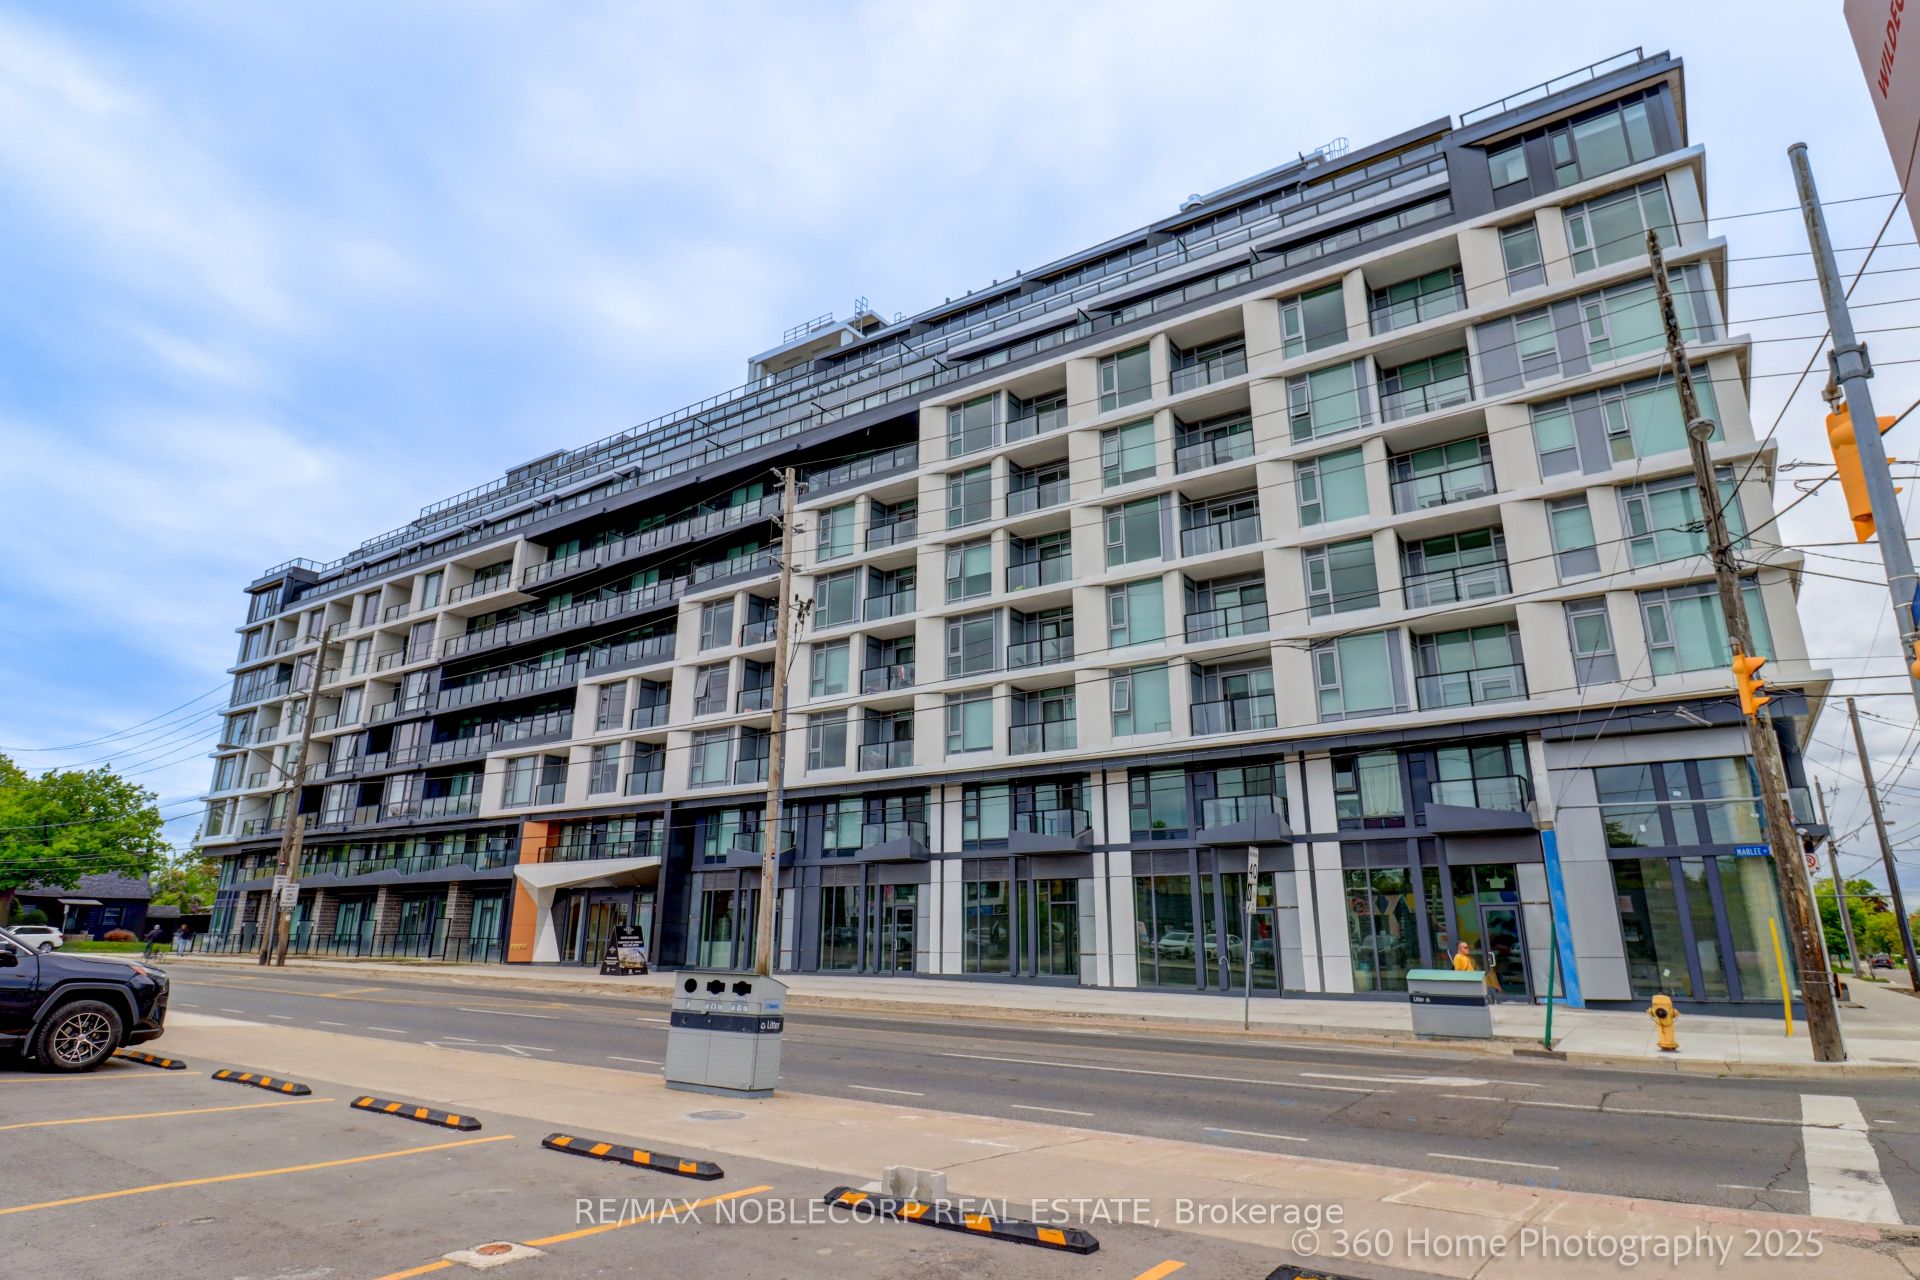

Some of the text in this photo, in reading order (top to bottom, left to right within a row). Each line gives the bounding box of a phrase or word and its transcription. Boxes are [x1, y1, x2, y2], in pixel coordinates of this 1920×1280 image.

[1736, 847, 1762, 856] MARLEE
[1249, 864, 1258, 879] 40
[767, 1020, 780, 1029] Litter
